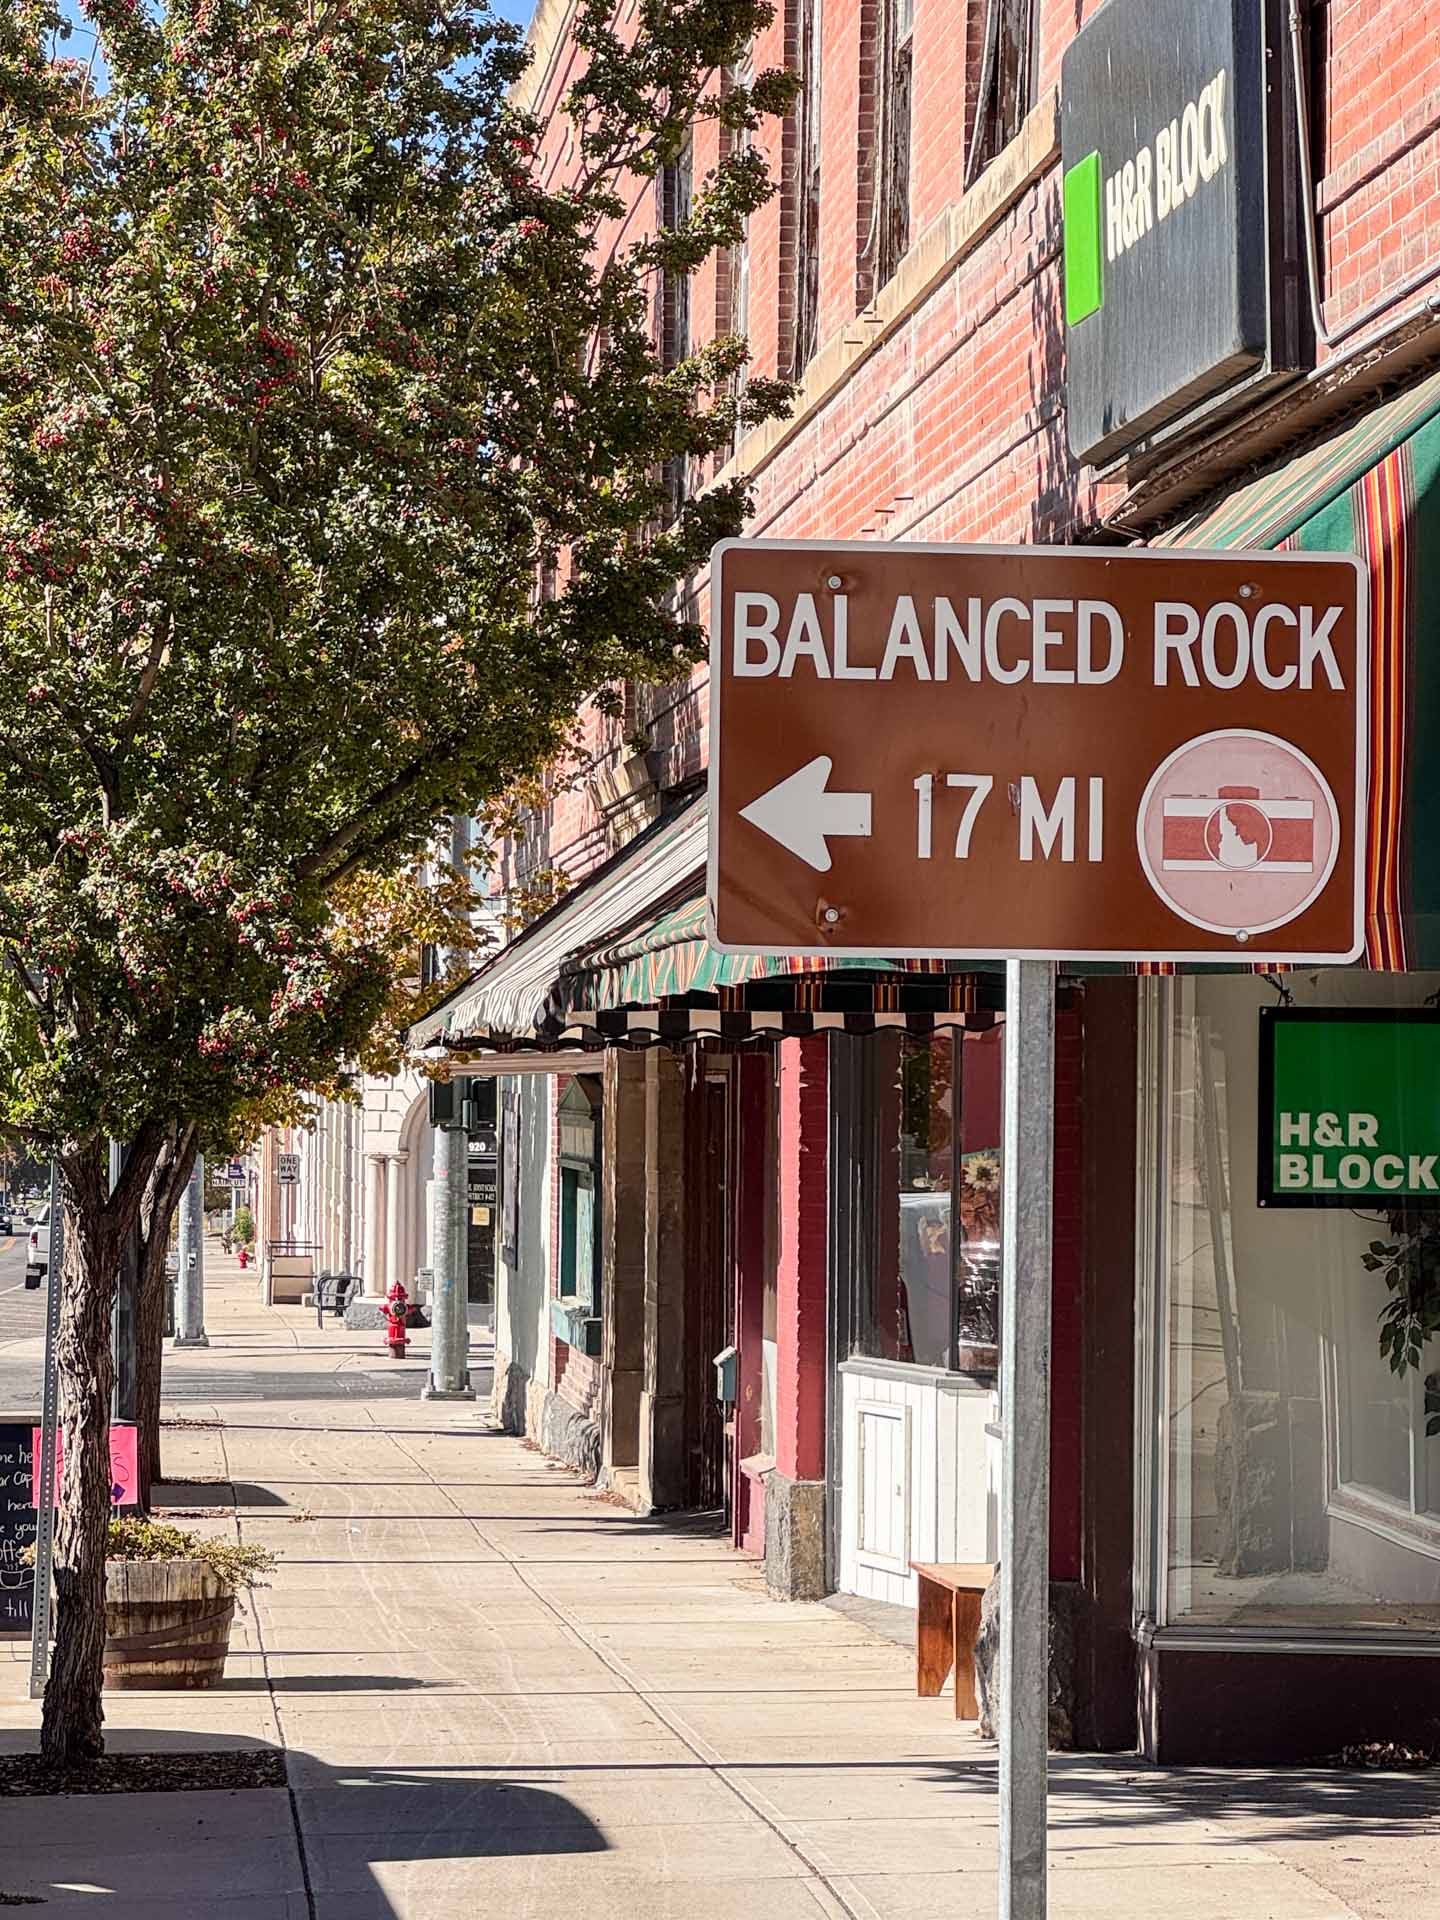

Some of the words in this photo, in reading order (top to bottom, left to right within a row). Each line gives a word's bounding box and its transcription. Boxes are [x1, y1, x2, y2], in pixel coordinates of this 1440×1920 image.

[1106, 146, 1153, 263] H&R
[1156, 68, 1228, 222] BLOCK
[732, 591, 1124, 685] BALANCED
[1153, 602, 1345, 690] ROCK
[913, 774, 994, 859] 17
[1019, 776, 1104, 863] MI
[468, 1142, 486, 1152] 920
[1279, 1112, 1379, 1147] H&R
[280, 1157, 297, 1165] ONE
[280, 1165, 297, 1173] WAY
[1279, 1154, 1440, 1190] BLOCK
